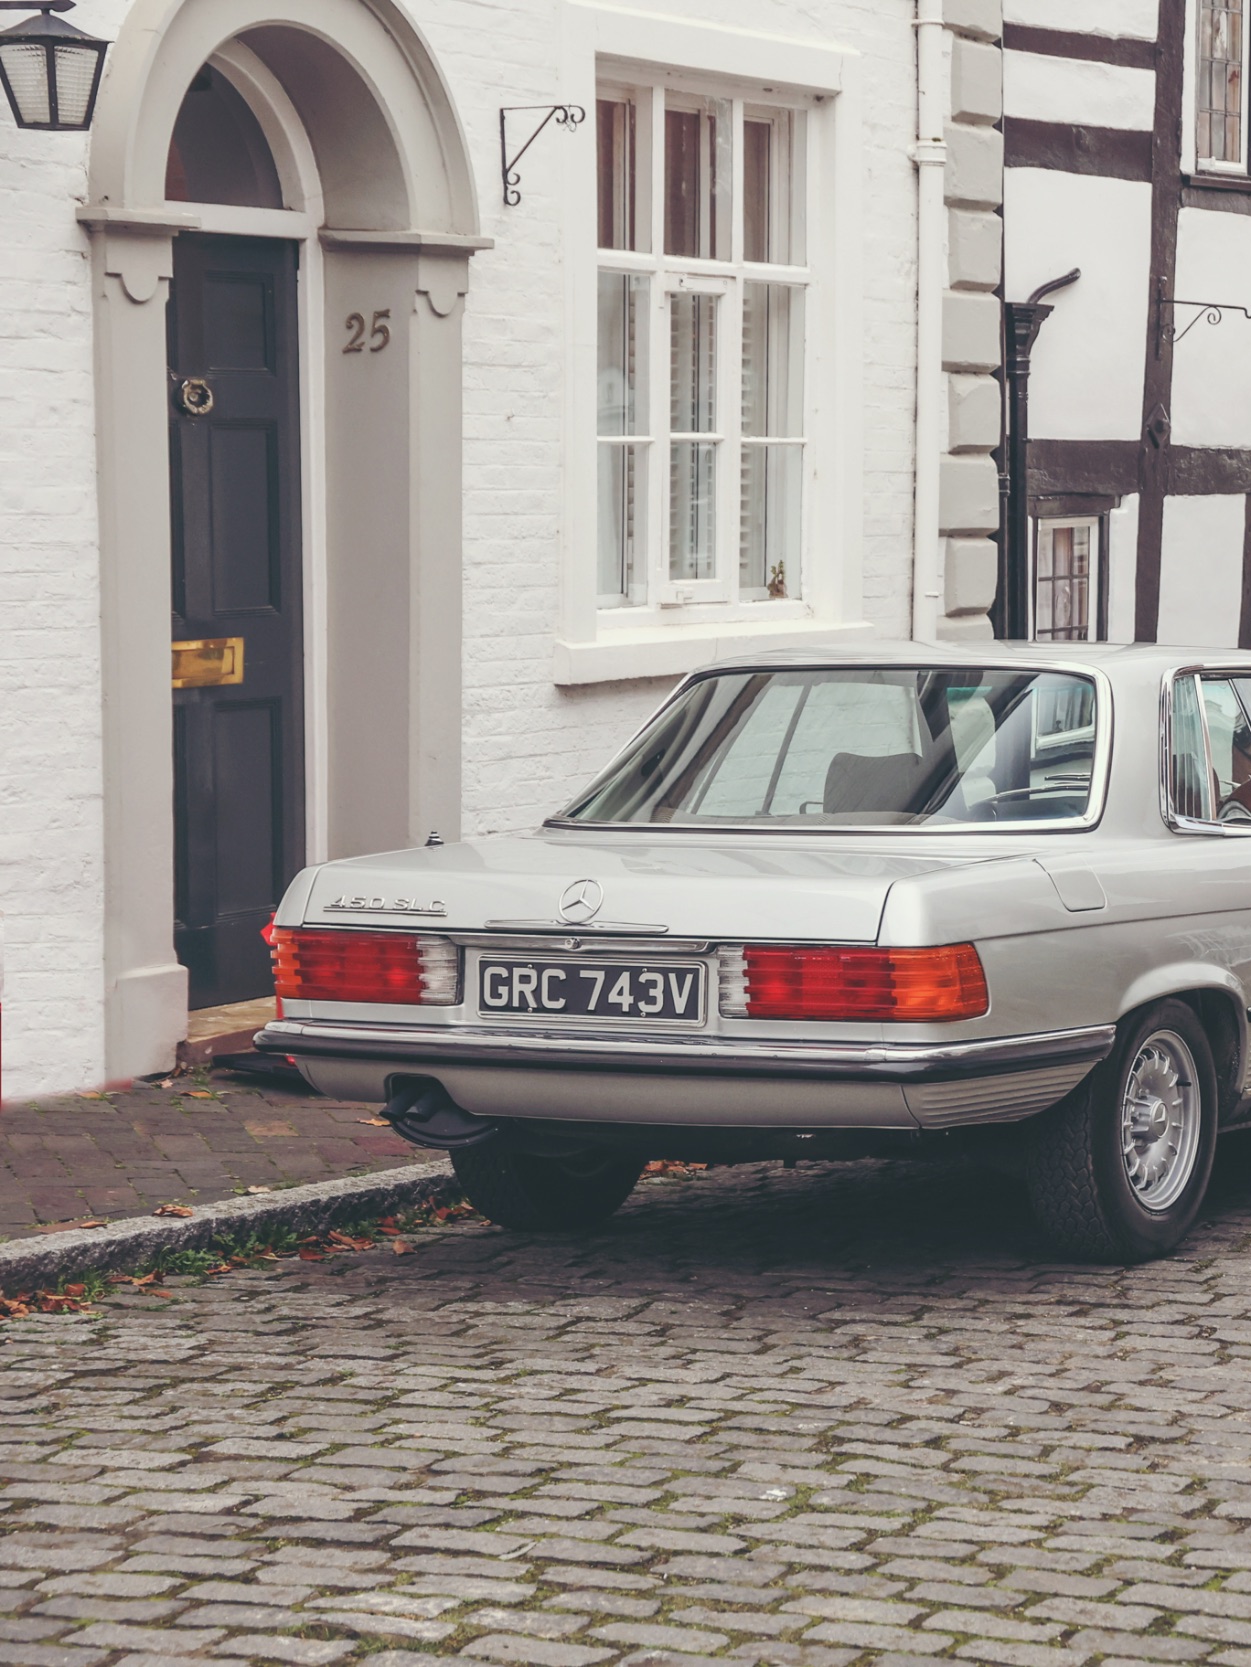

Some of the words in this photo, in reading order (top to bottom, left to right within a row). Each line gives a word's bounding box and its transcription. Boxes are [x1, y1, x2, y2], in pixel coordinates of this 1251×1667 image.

[342, 309, 391, 354] 25
[330, 895, 386, 910] 450
[483, 966, 567, 1009] GRC
[579, 969, 694, 1014] 743V
